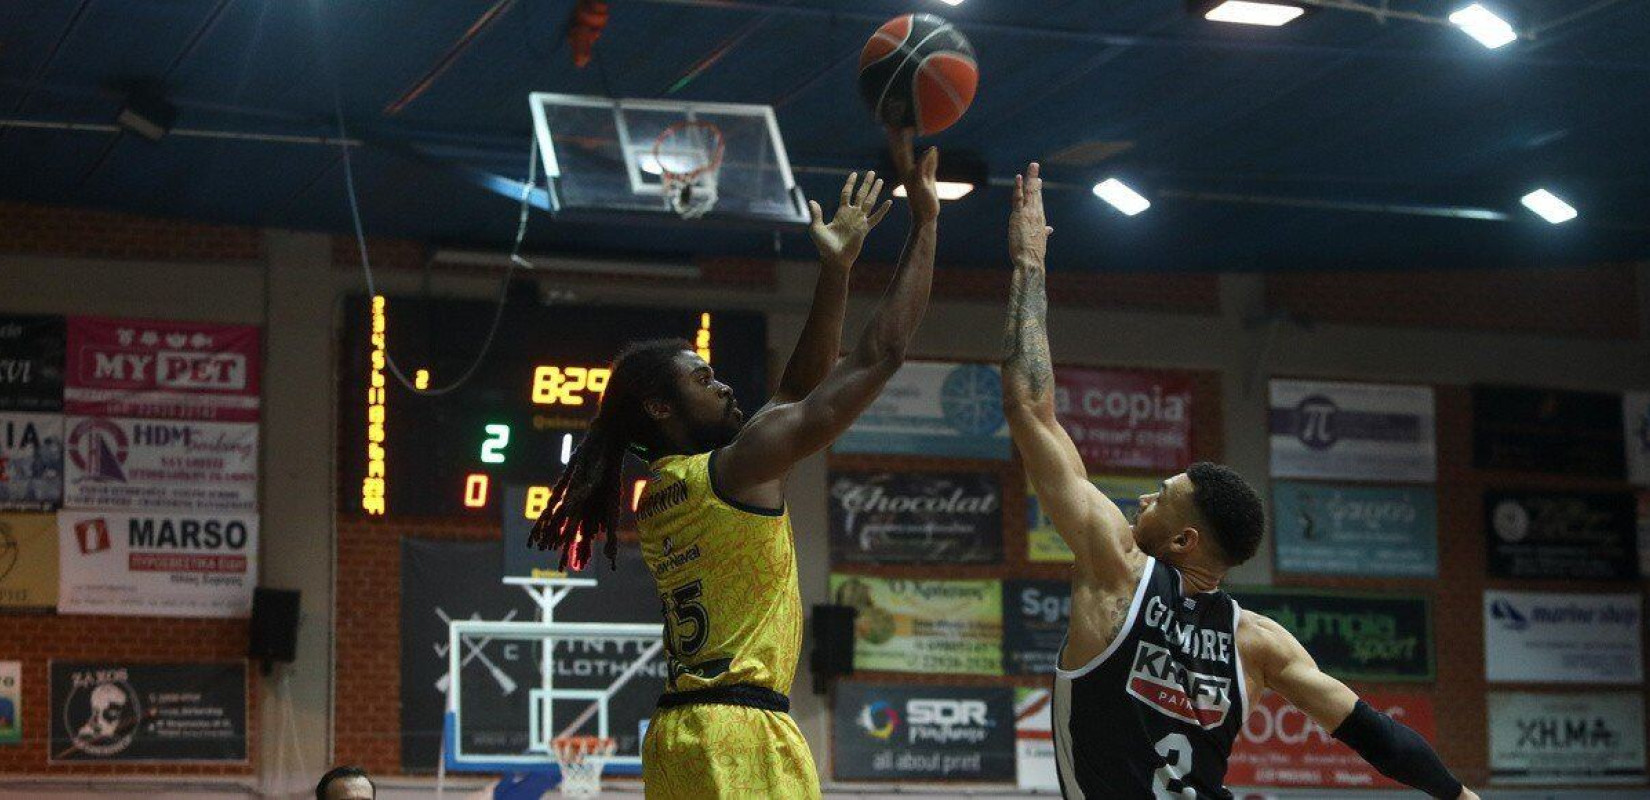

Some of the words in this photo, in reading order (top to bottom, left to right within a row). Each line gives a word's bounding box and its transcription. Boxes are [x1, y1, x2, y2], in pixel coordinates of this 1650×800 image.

[94, 352, 154, 382] MY
[164, 358, 240, 386] PET
[531, 366, 613, 406] 8:29
[1083, 386, 1184, 431] copia
[480, 424, 510, 464] 2
[463, 474, 489, 508] 0
[838, 484, 997, 516] Chocolat
[128, 517, 248, 550] MARSO
